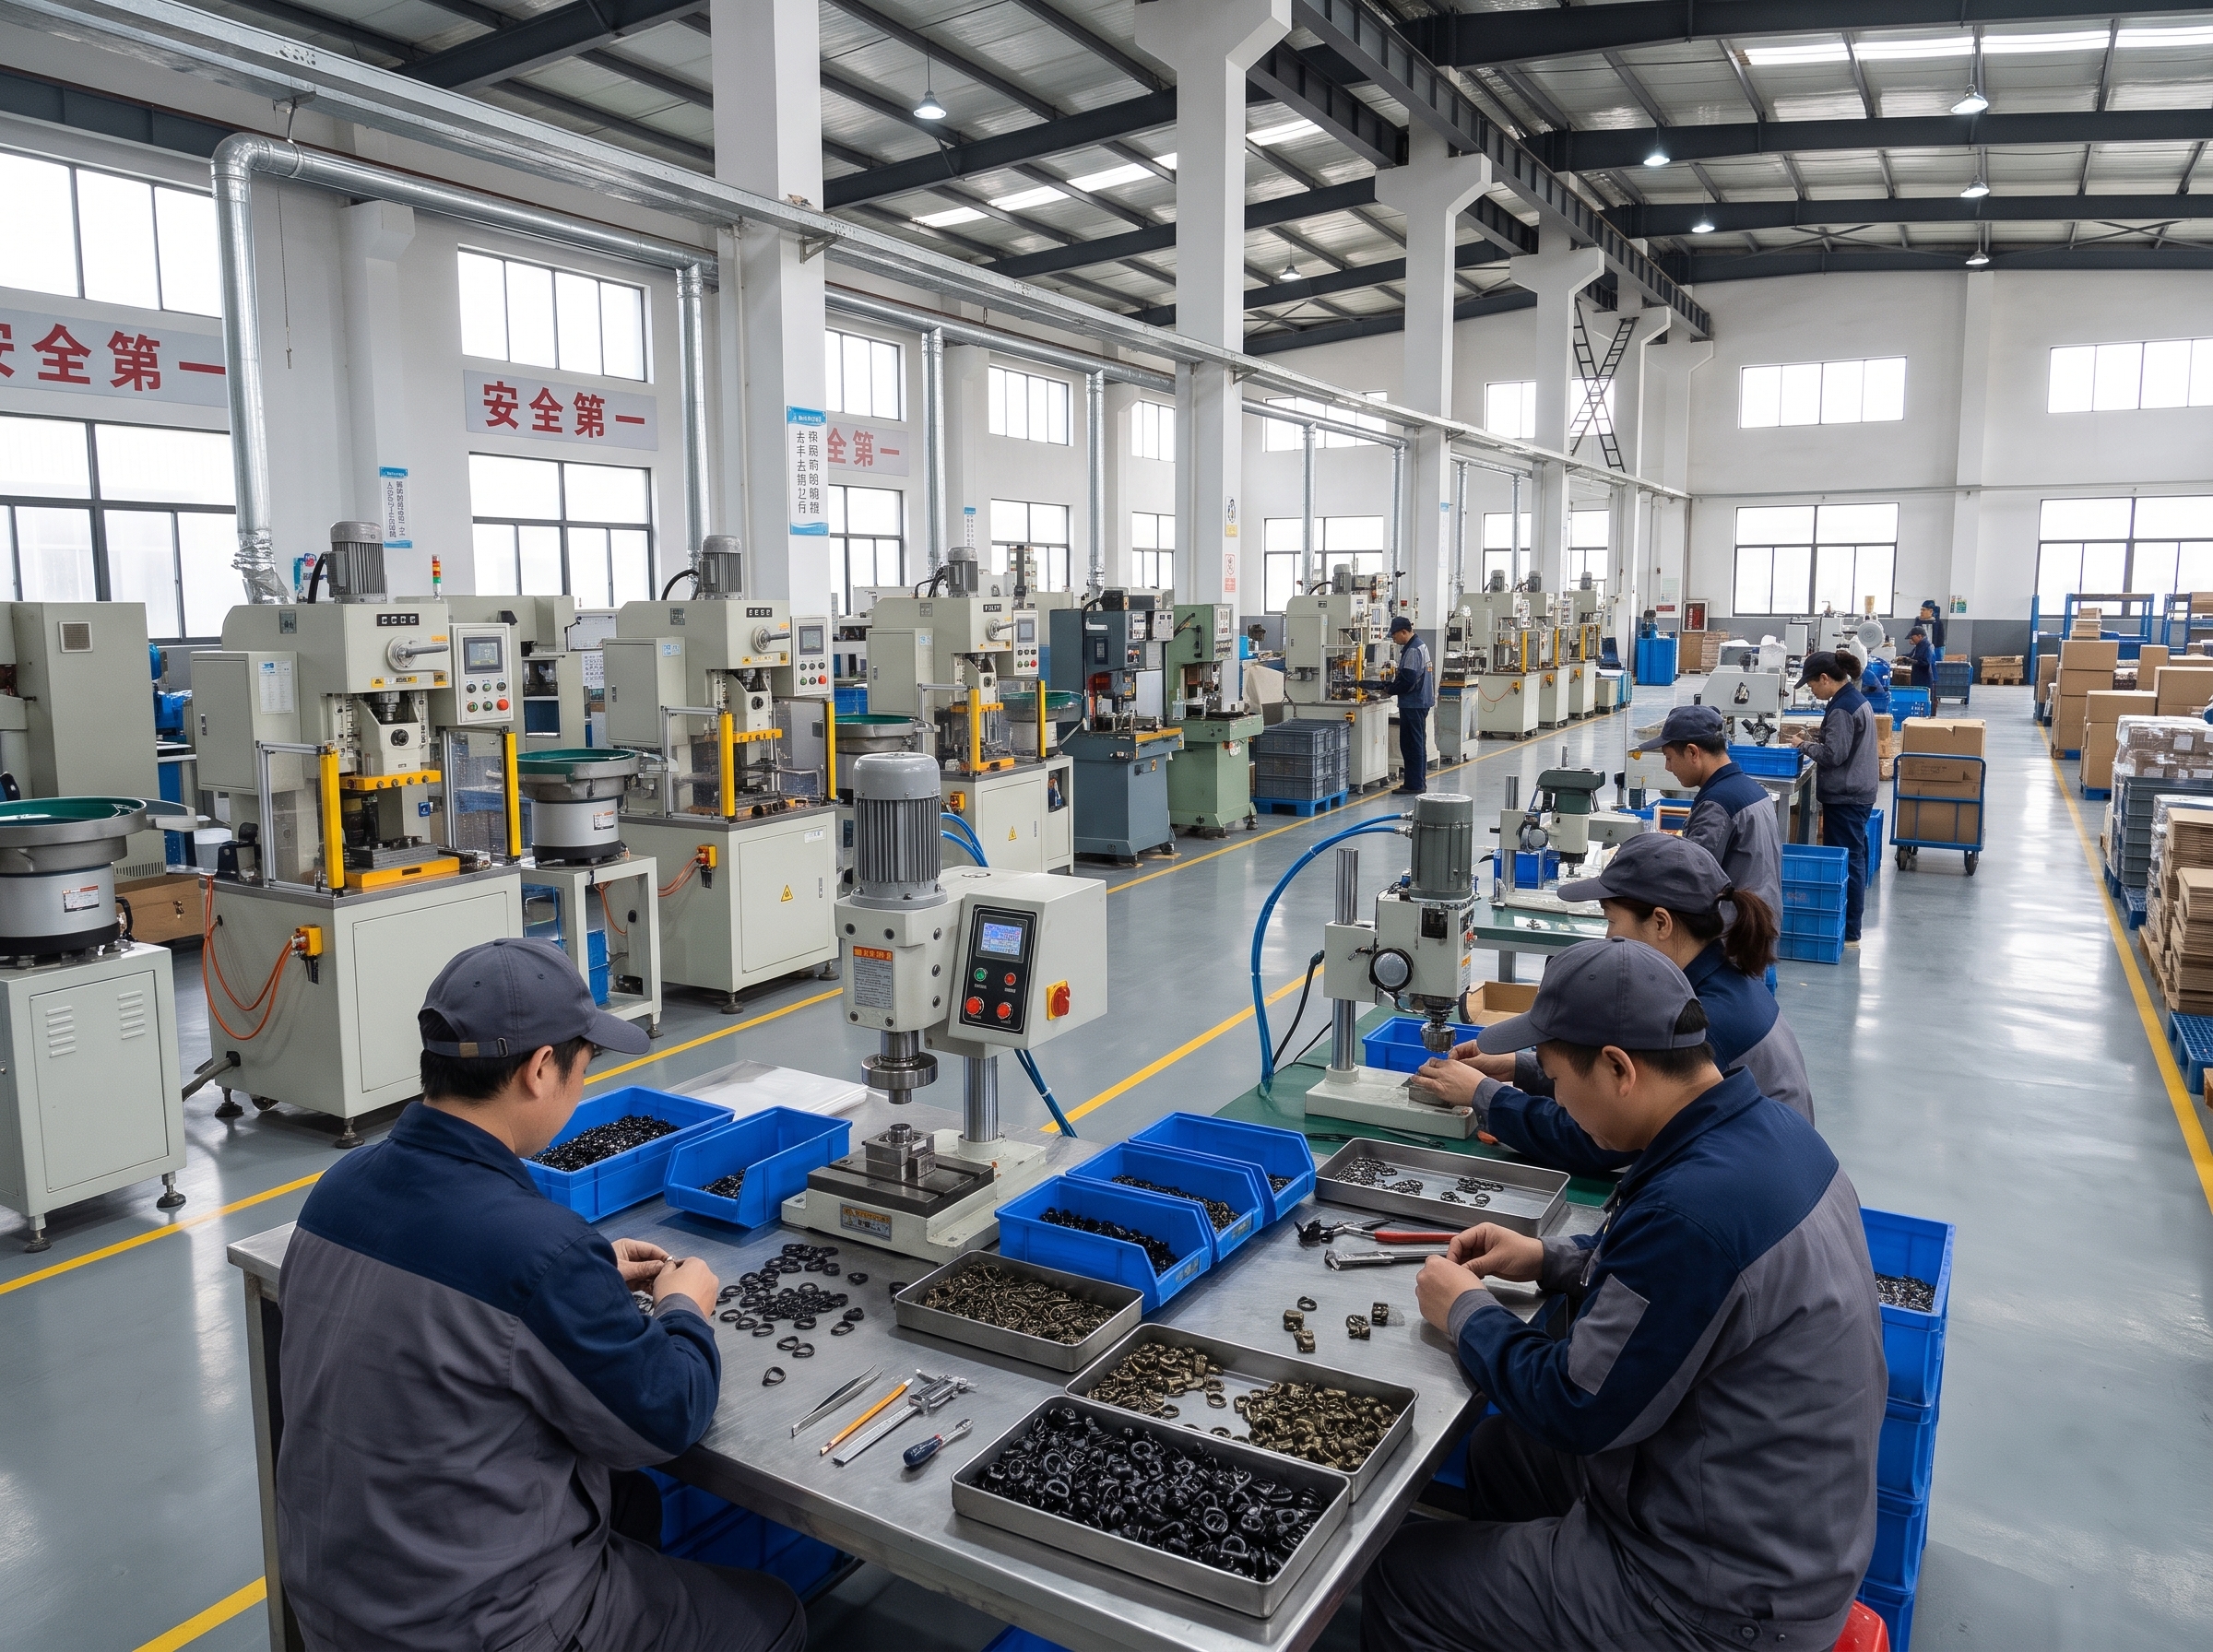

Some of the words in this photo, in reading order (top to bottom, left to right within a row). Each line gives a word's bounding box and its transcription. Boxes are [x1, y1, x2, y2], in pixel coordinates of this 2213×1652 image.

[0, 323, 226, 392] 全第一
[483, 380, 645, 439] 安全第一
[827, 427, 900, 467] 全第一
